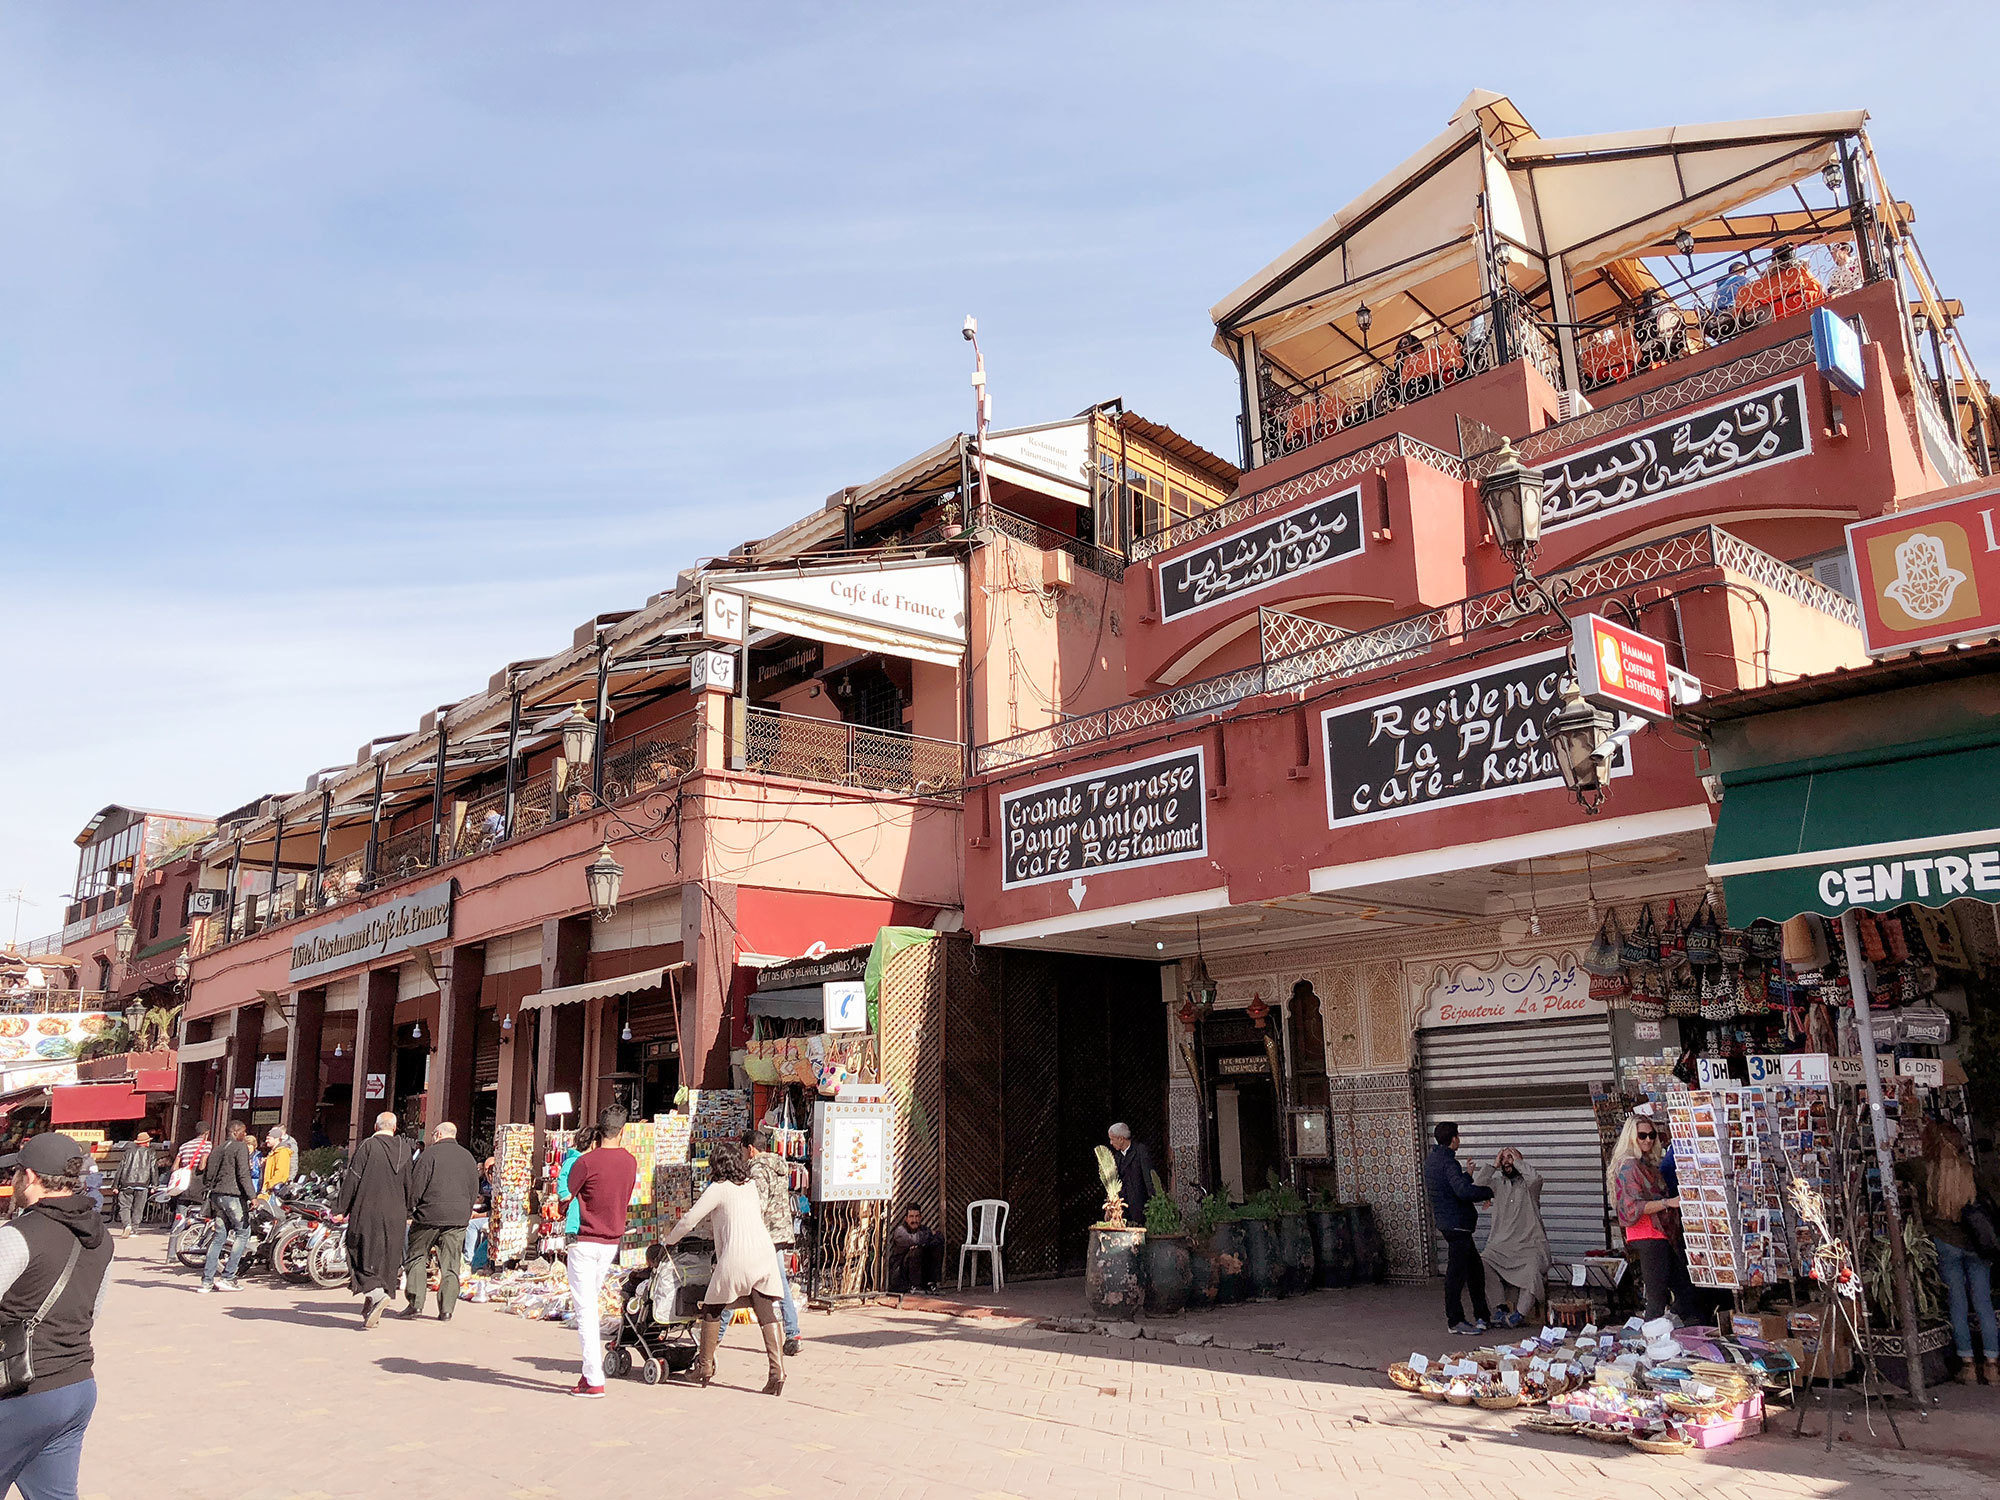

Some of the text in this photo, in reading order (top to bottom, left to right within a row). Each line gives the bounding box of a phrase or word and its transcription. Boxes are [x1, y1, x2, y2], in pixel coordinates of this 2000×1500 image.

[1177, 511, 1349, 592] منظر شامل
[830, 579, 946, 620] Café de France
[757, 647, 818, 684] Panoramique
[1395, 736, 1439, 775] La
[1009, 765, 1195, 830] Grande Terrasse
[1082, 821, 1200, 867] Restaurant
[1818, 850, 2000, 907] CENTRE
[317, 923, 371, 965] Restaurant
[370, 909, 397, 954] Café
[395, 905, 410, 936] de
[408, 902, 449, 935] France
[1444, 965, 1577, 998] مجوهرات الساحة
[1440, 995, 1586, 1024] Bijouterie La Place
[1699, 1059, 1728, 1083] 3 DH
[1751, 1056, 1781, 1081] 3 DH
[1787, 1059, 1805, 1081] 4
[1832, 1060, 1862, 1072] 4 Dhs
[1877, 1057, 1889, 1068] hs
[1904, 1062, 1938, 1073] 6 Dhs
